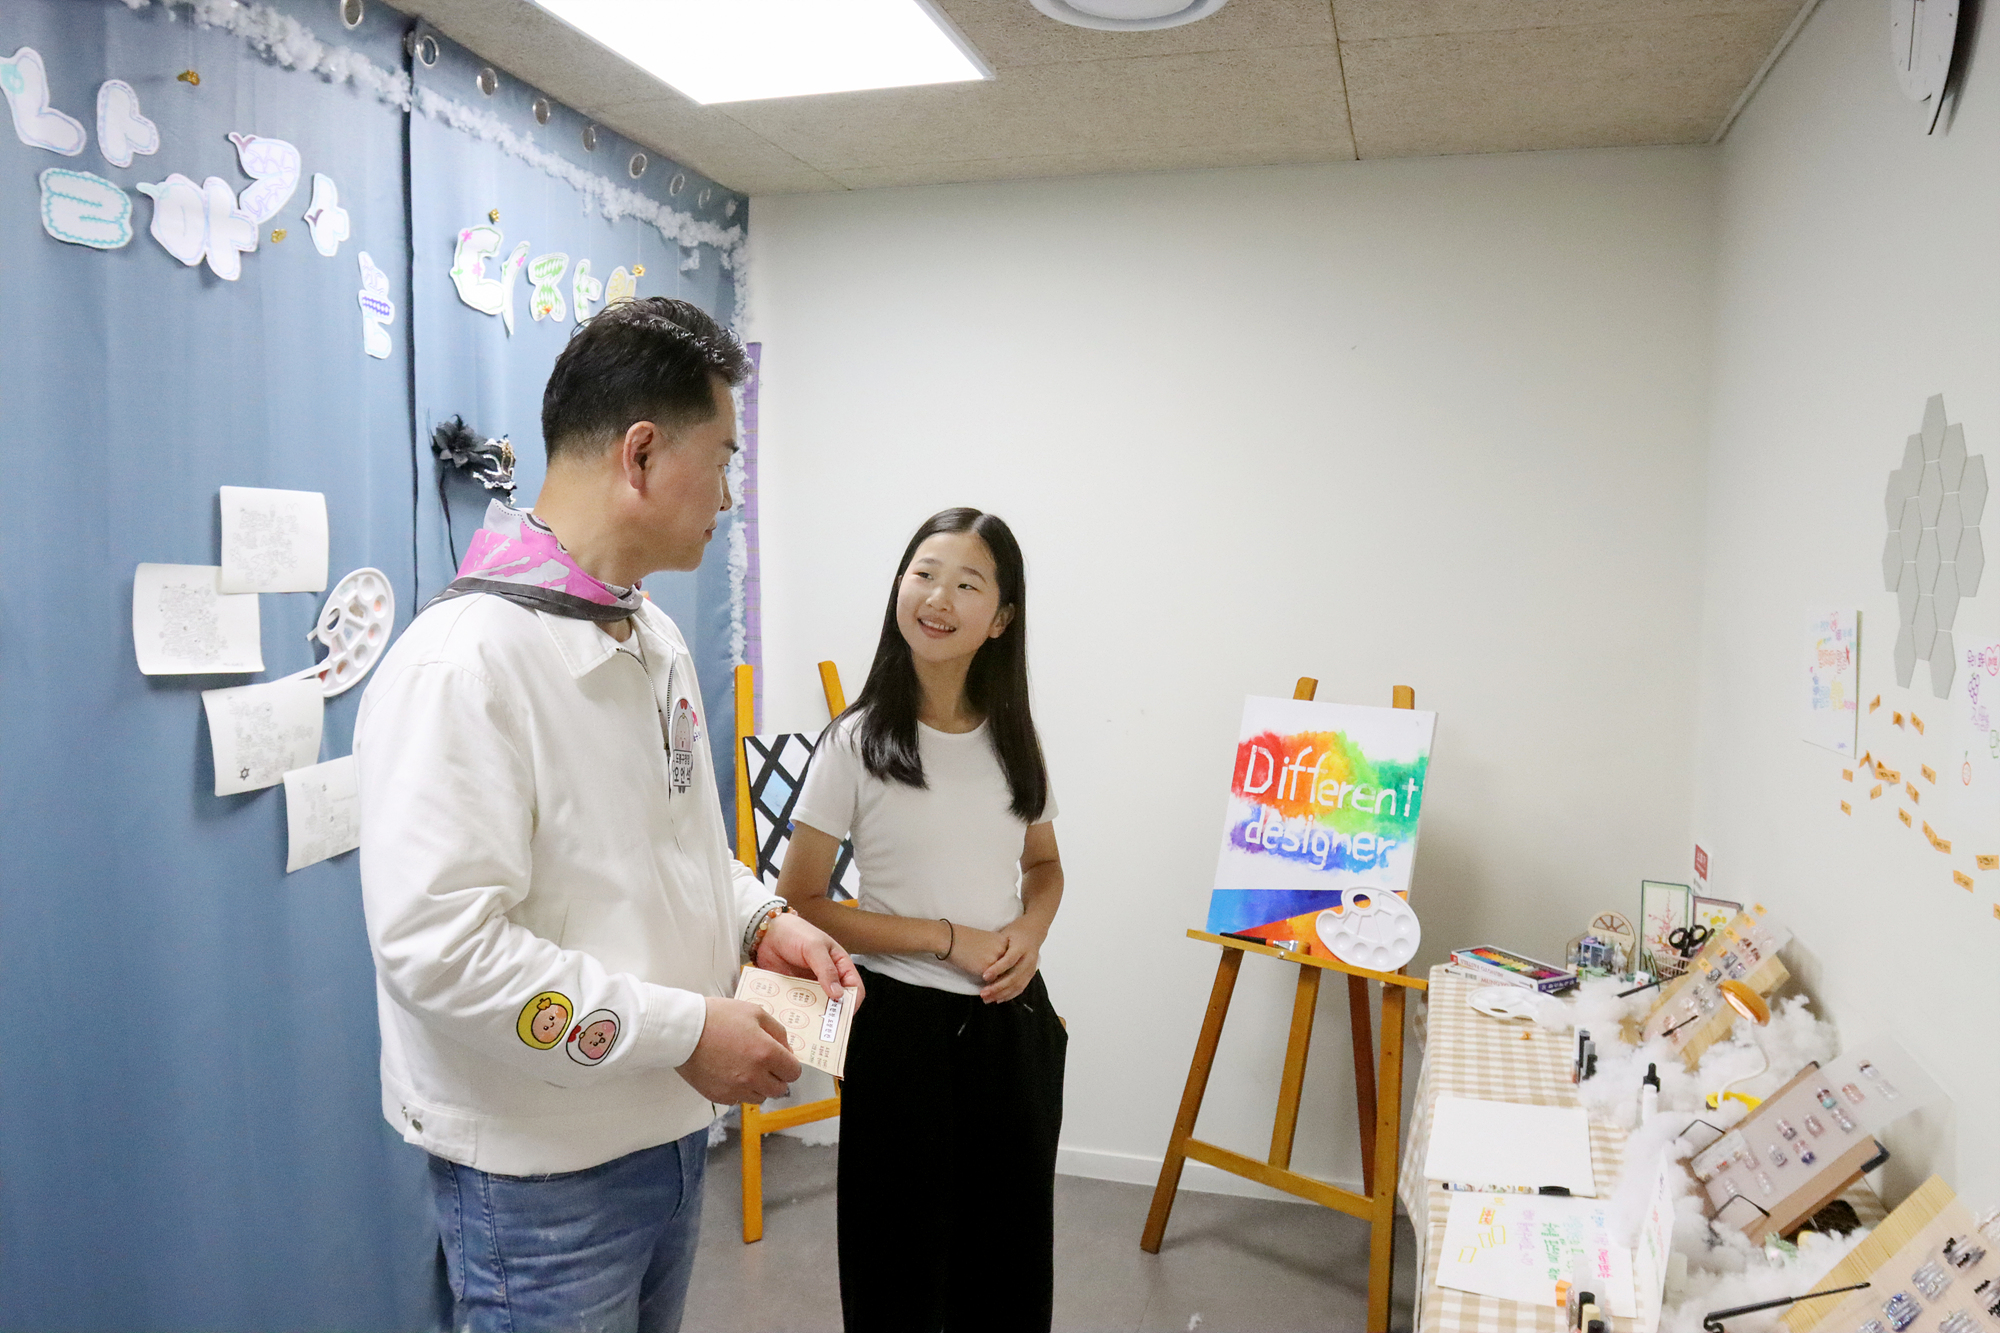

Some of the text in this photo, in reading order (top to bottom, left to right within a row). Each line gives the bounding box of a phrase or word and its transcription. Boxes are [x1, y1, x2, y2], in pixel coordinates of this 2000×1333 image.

[674, 766, 691, 784] 오언석
[675, 754, 690, 765] 도봉구청장
[1243, 745, 1419, 817] Different
[1245, 803, 1396, 870] designer
